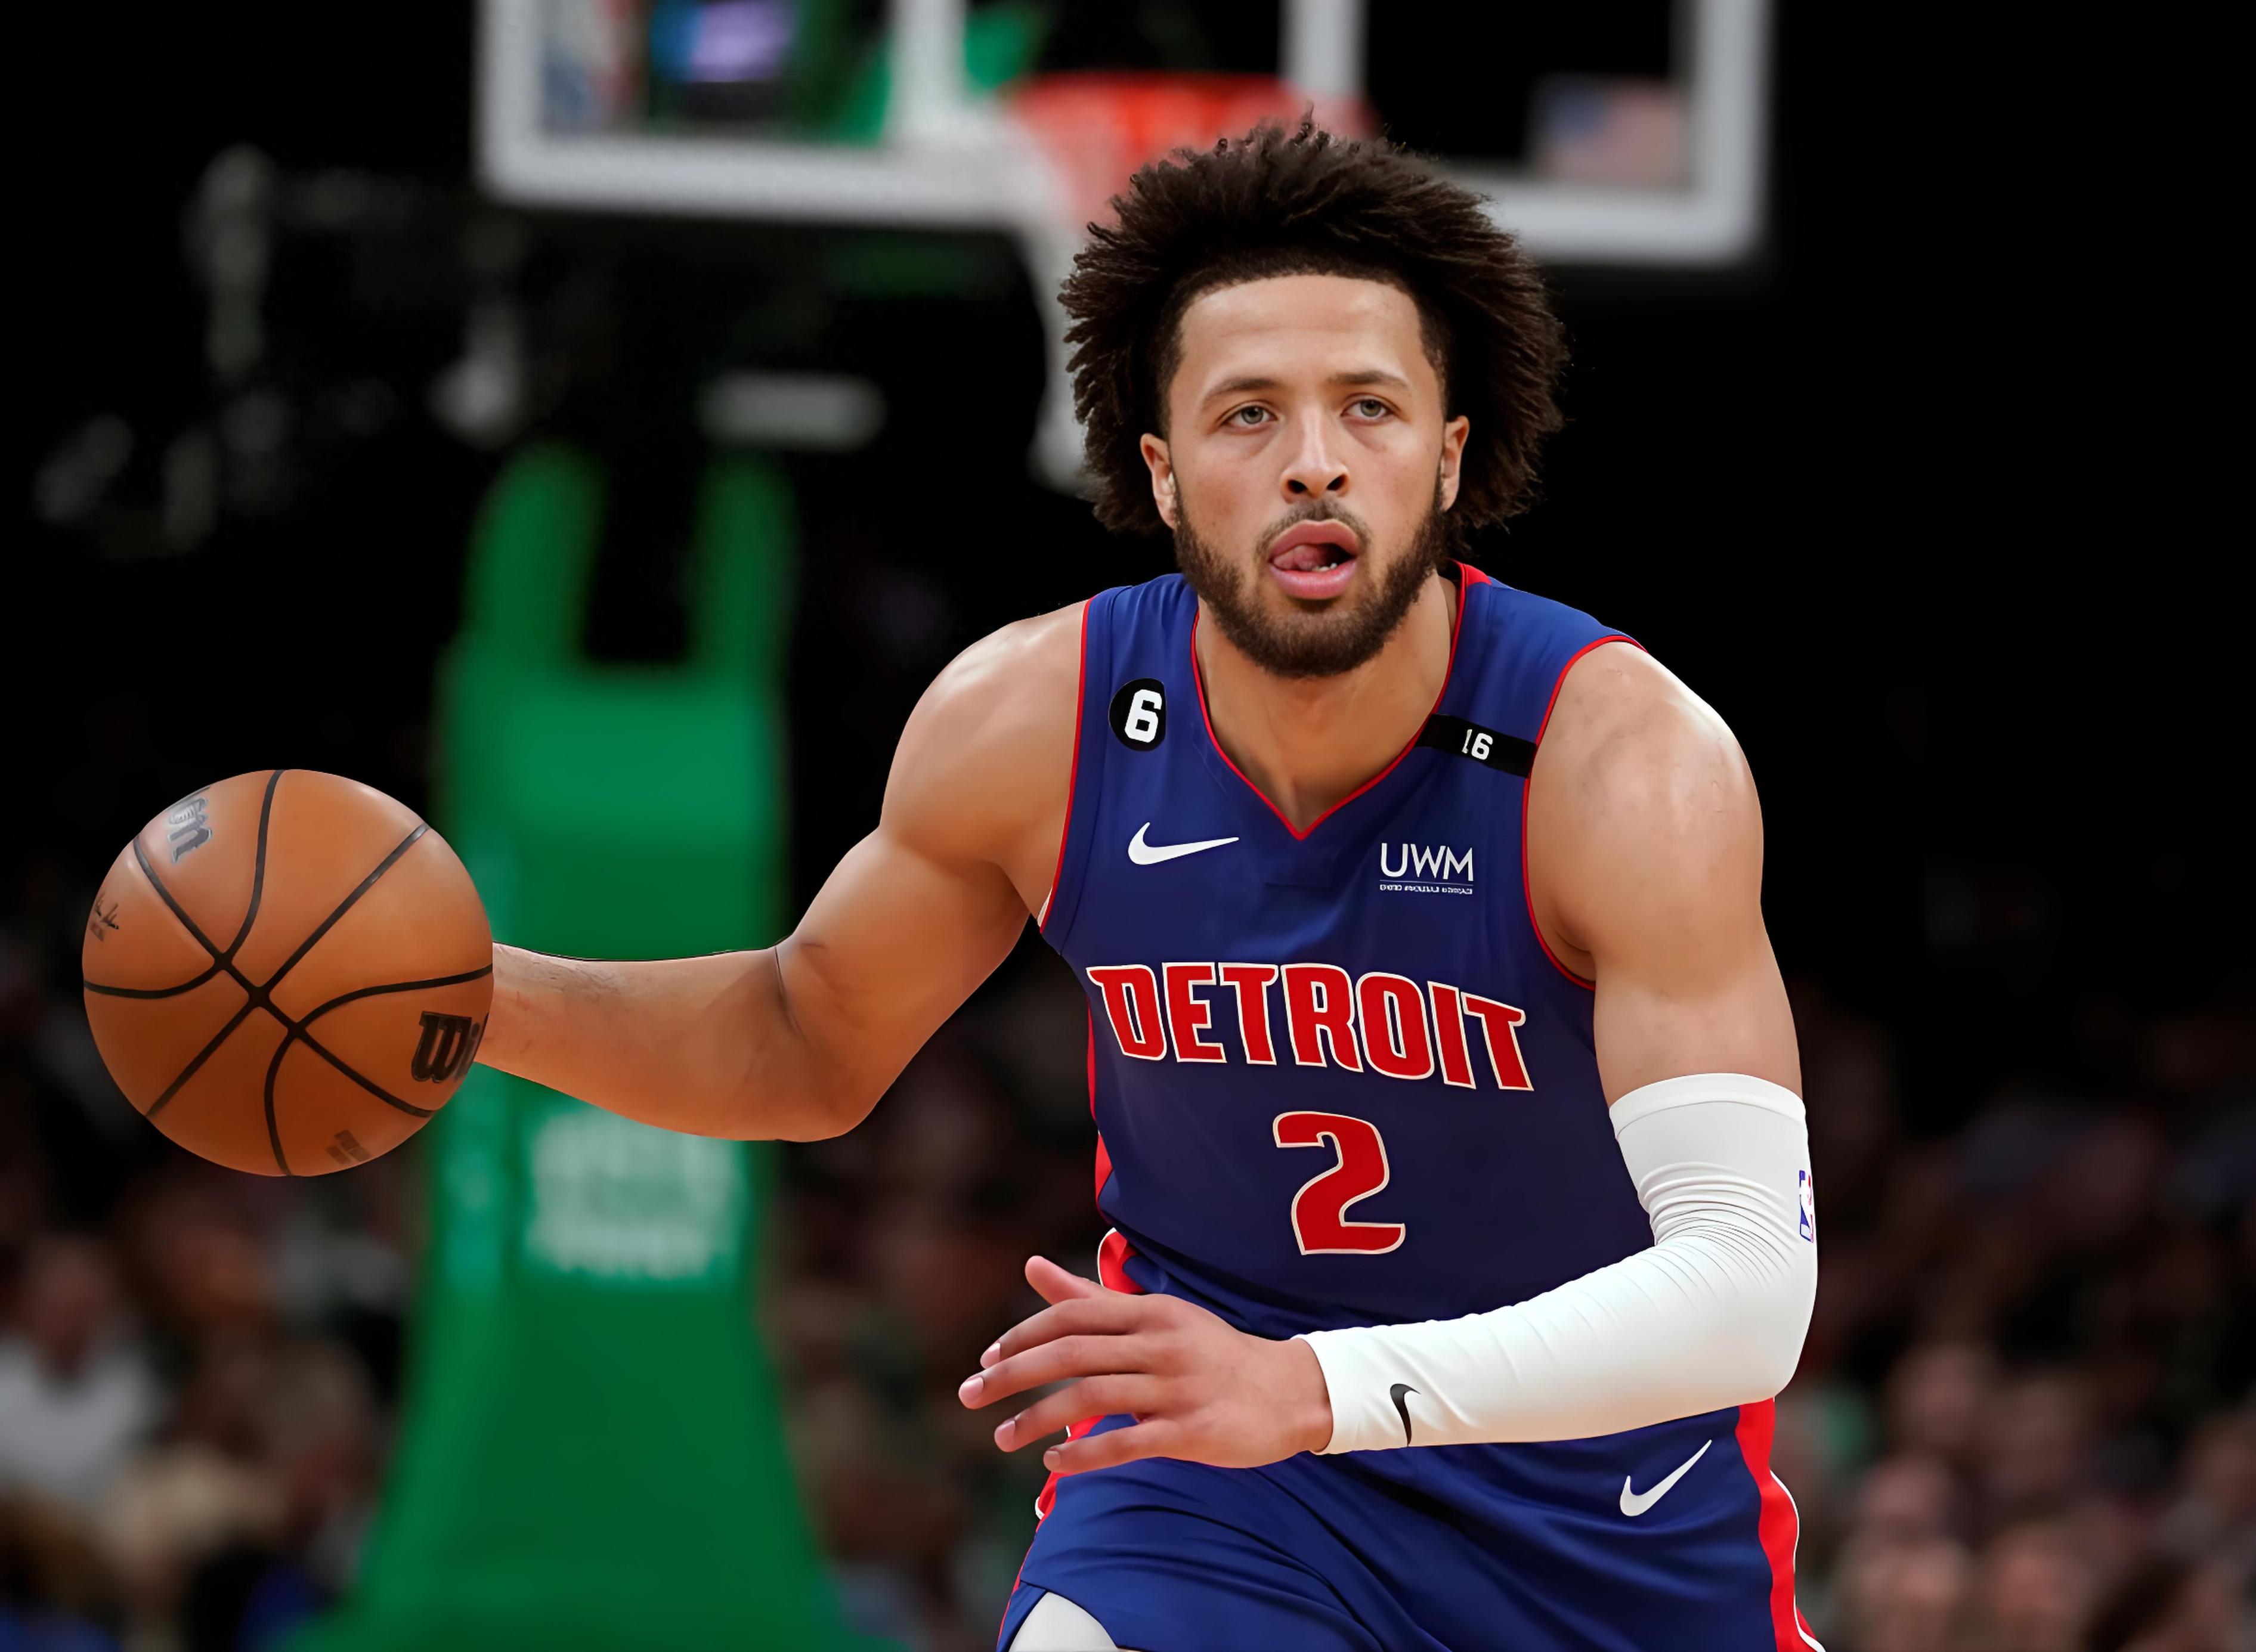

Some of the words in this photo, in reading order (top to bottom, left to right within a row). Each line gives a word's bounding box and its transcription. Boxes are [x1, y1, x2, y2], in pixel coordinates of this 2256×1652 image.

[1124, 689, 1162, 743] 6
[1462, 729, 1493, 760] 16
[1381, 842, 1474, 881] UWM
[1086, 962, 1534, 1091] DETROIT
[1273, 1111, 1406, 1255] 2
